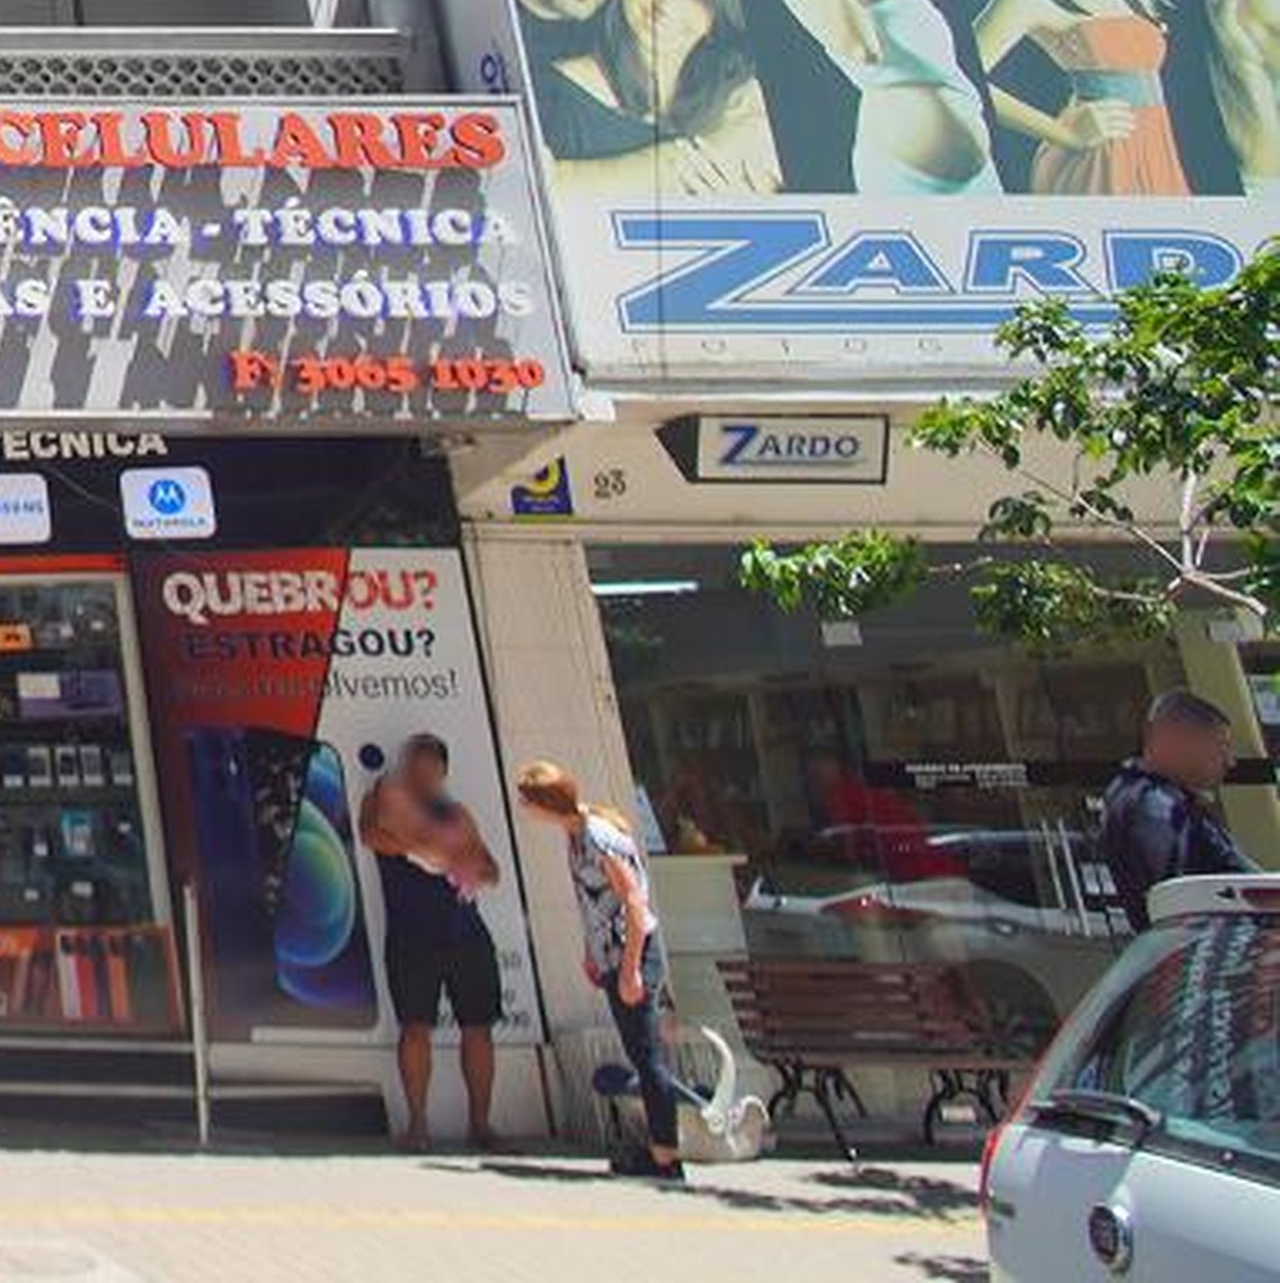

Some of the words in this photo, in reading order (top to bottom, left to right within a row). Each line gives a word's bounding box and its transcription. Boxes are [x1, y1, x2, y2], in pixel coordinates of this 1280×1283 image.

[233, 197, 518, 245] TÉCNICA
[76, 279, 116, 317] E
[143, 269, 532, 317] ACESSÓRIOS
[610, 211, 1275, 334] ZARD
[296, 357, 420, 392] 3065
[432, 358, 545, 392] 1030
[719, 425, 862, 467] ZARDO
[593, 469, 627, 498] 23
[161, 569, 436, 625] QUEBROU?
[186, 627, 436, 660] ESTRAGOU?
